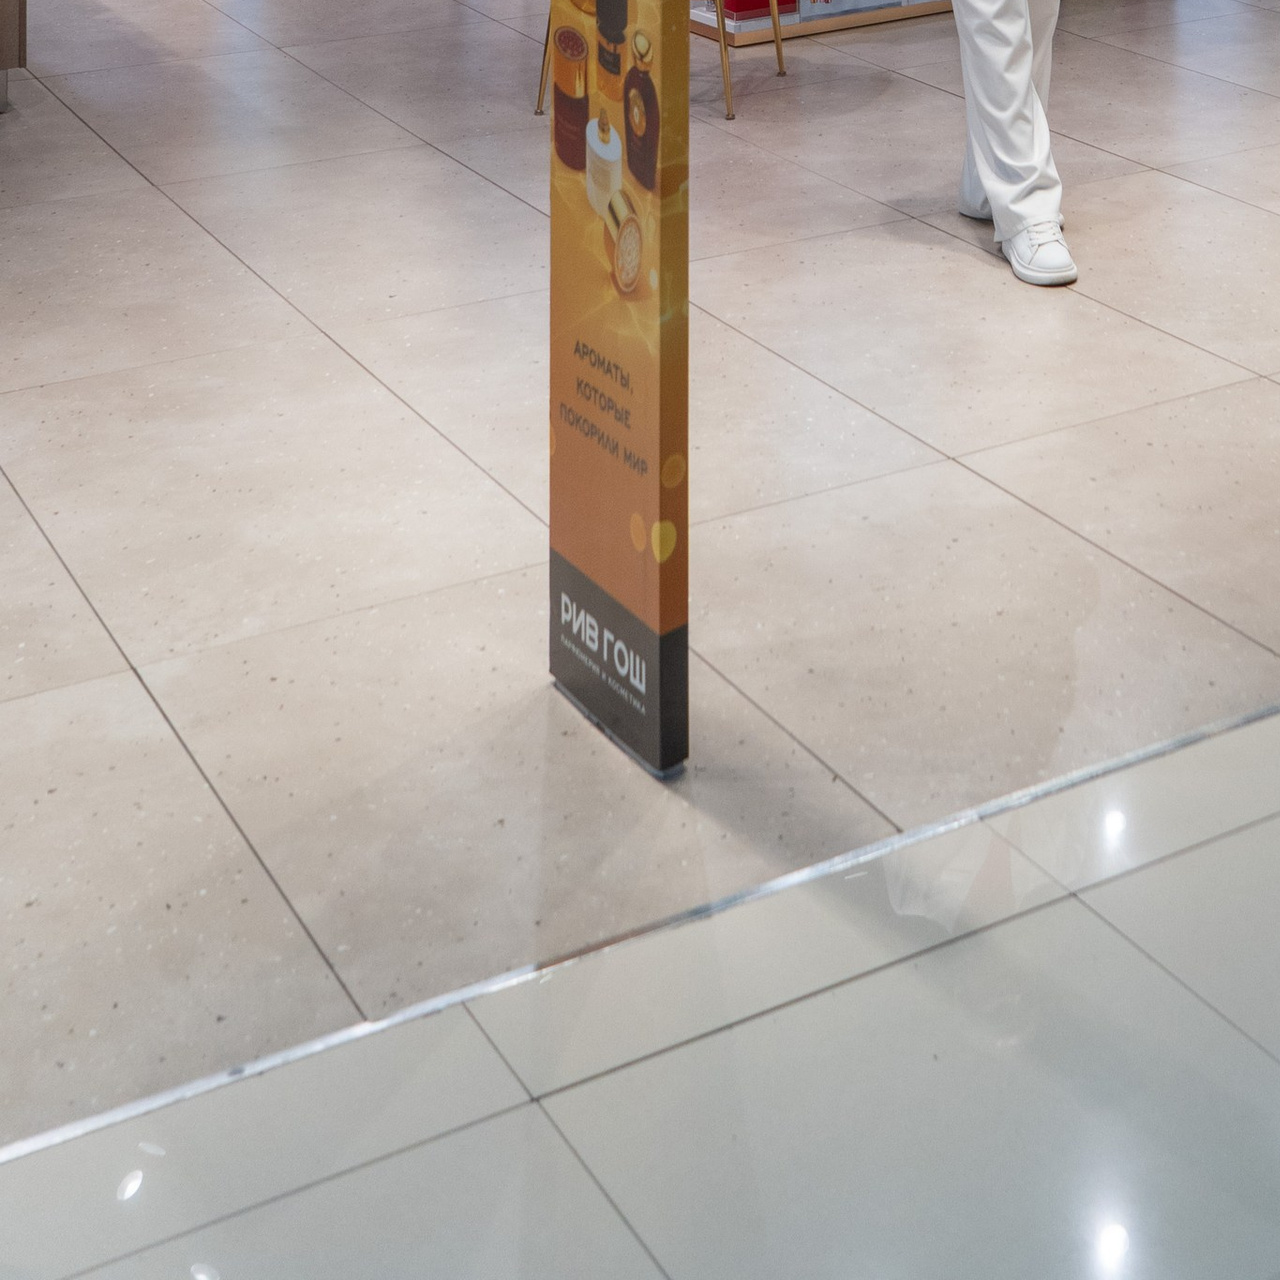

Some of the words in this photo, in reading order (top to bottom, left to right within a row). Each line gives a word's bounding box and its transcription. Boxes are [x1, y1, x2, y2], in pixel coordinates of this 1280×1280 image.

[574, 340, 634, 395] АРОМАТЫ,
[576, 376, 631, 430] КОТОРЫЕ
[559, 402, 620, 461] ПОКОРИЛИ
[623, 449, 649, 477] МИР
[561, 591, 599, 653] РИВ
[603, 628, 647, 696] ГОШ
